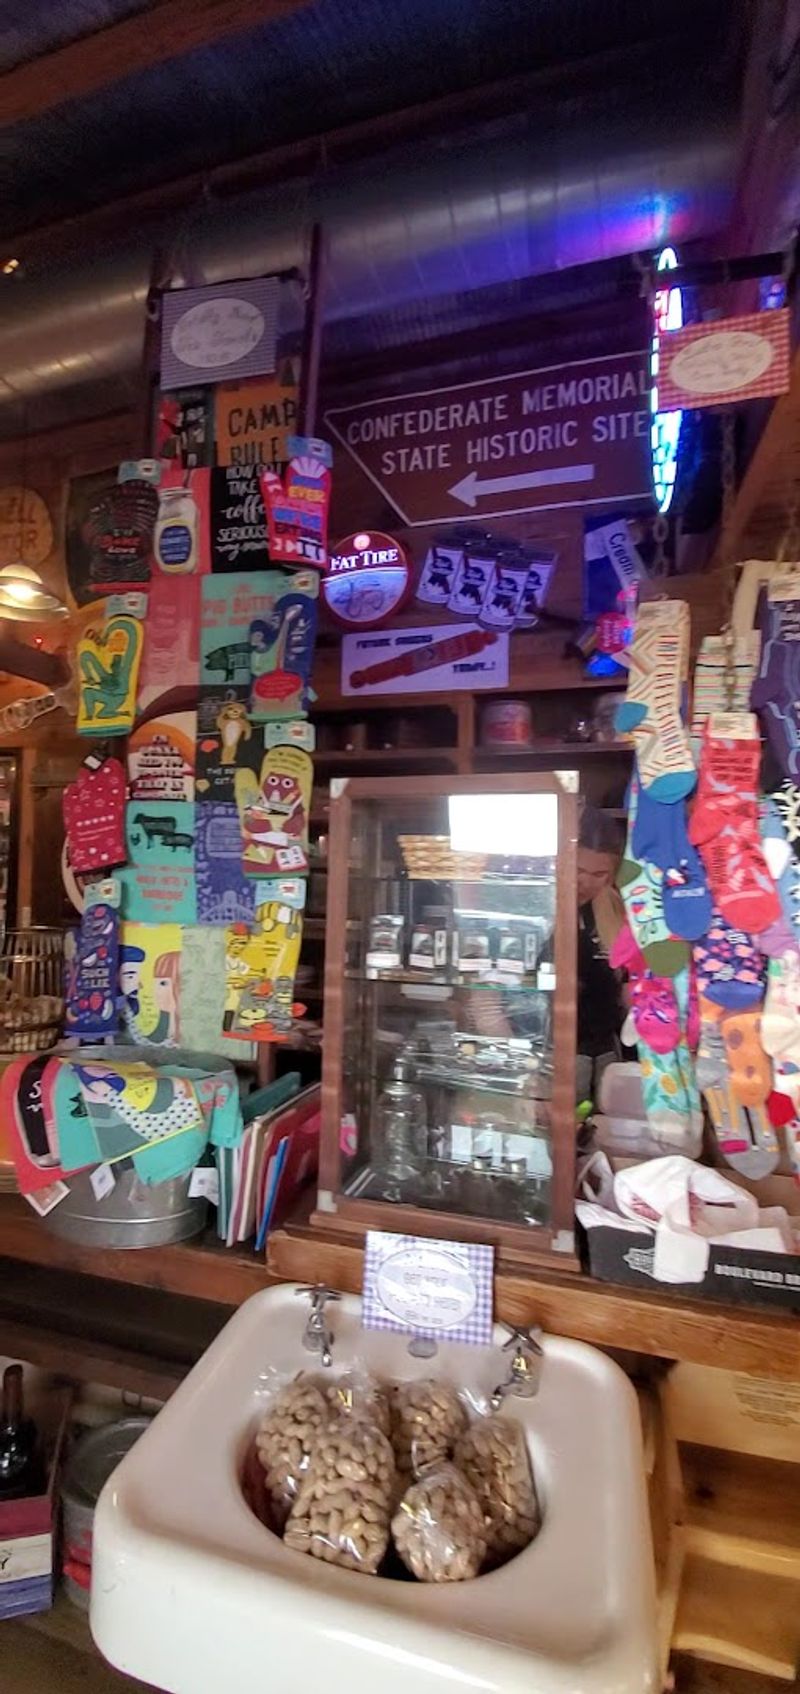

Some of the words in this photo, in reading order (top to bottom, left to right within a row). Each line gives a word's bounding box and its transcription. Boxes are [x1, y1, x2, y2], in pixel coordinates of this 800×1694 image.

[228, 398, 295, 437] CAMP
[347, 395, 508, 445] CONFEDERATE
[522, 370, 650, 416] MEMORIAL
[230, 437, 280, 464] RULE
[381, 444, 451, 475] STATE
[466, 420, 578, 464] HISTORIC
[592, 411, 649, 442] SITE
[220, 494, 267, 523] coffe
[330, 553, 359, 571] FAT
[363, 549, 398, 567] TIRE
